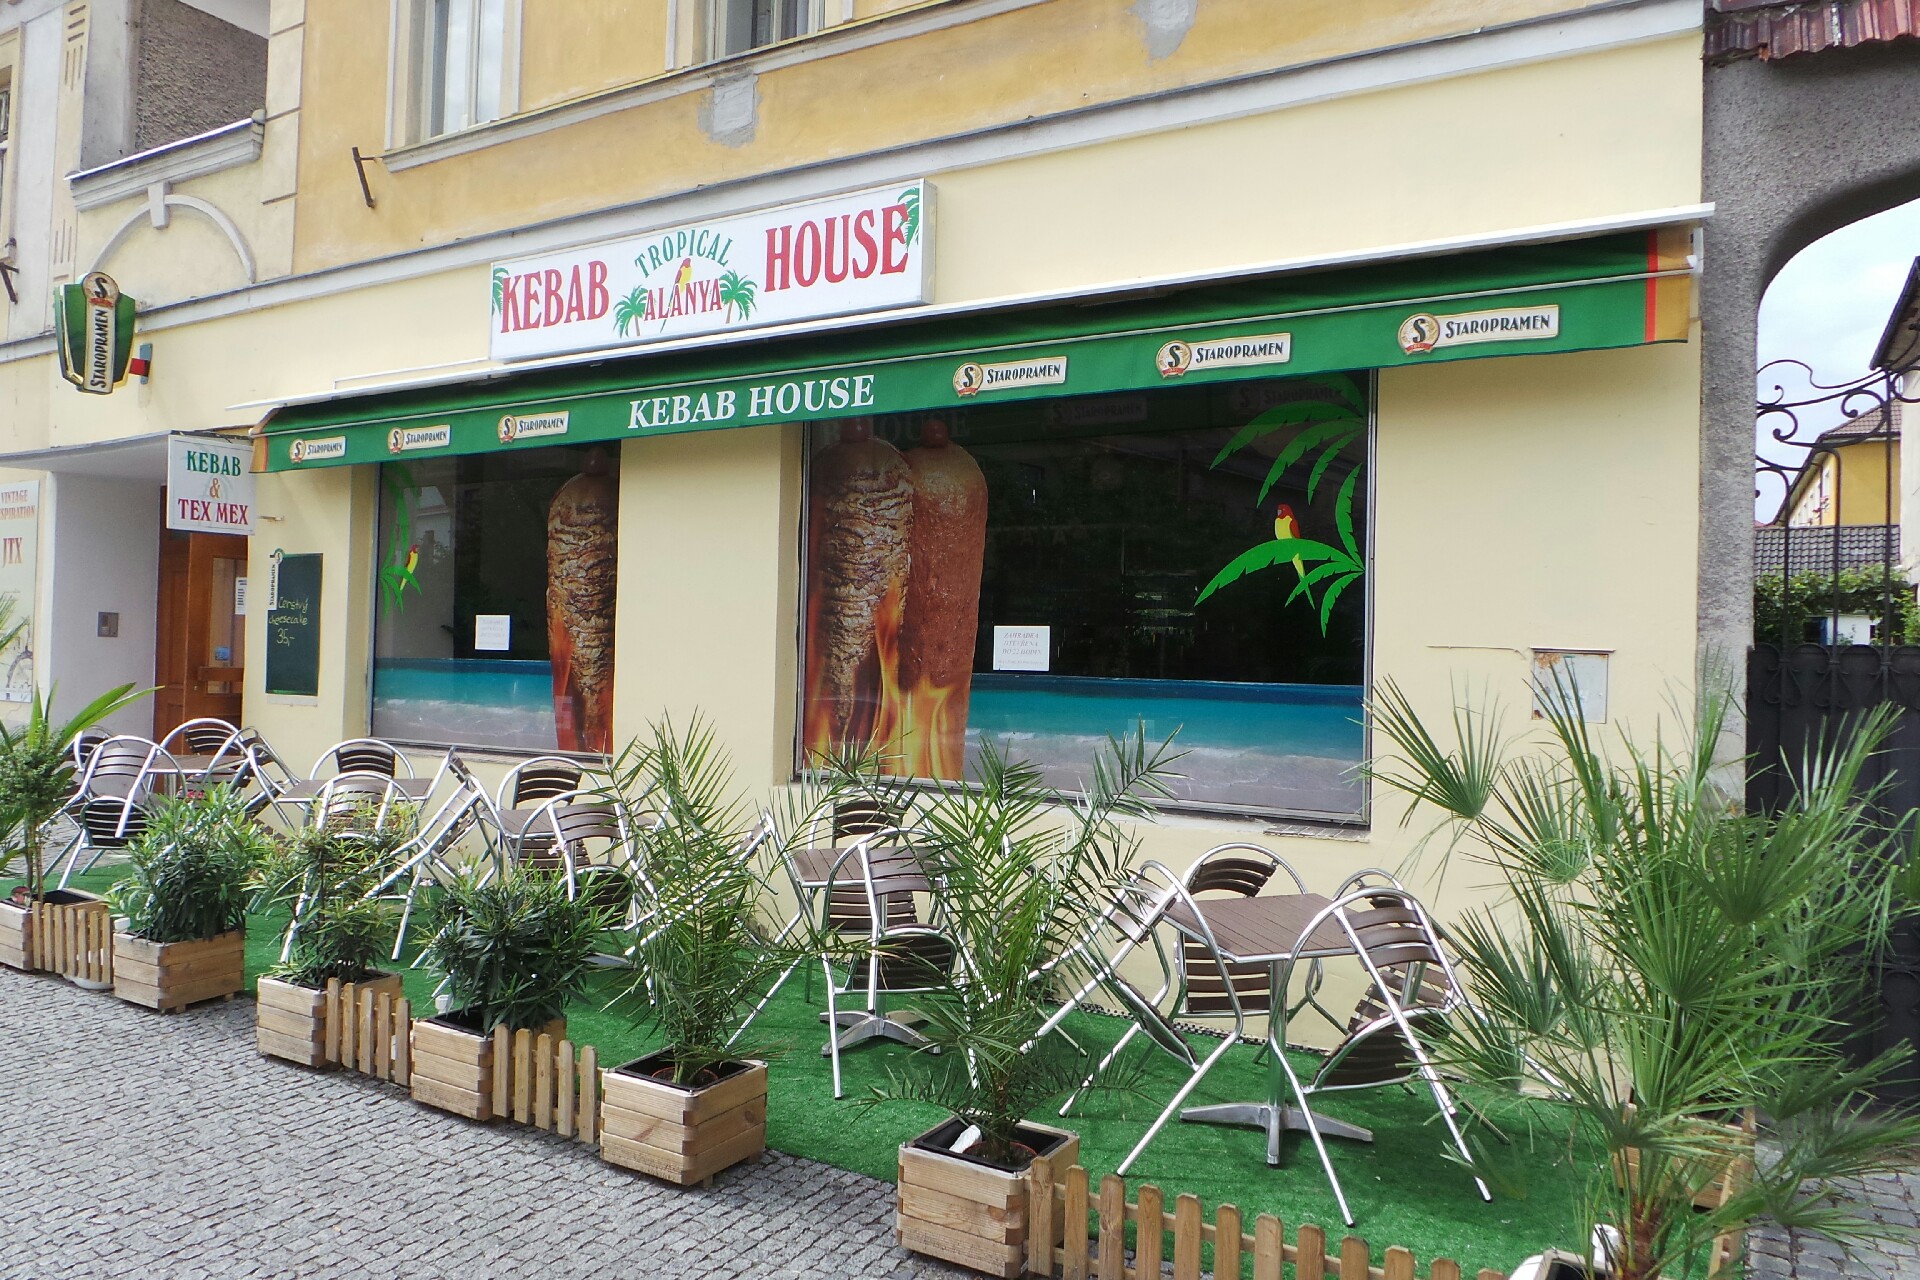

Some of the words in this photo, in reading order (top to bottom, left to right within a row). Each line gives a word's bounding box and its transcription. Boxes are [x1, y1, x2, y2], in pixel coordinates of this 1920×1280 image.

[634, 229, 734, 278] TROPICAL
[500, 260, 610, 334] KEBAB
[764, 202, 909, 294] HOUSE
[643, 278, 723, 322] ALANYA
[1445, 314, 1551, 339] STAROPRAMEN
[90, 309, 109, 389] STAROPRAMEN
[1195, 341, 1284, 363] STAROPRAMEN
[987, 363, 1061, 384] STAROPRAMEN
[627, 390, 737, 430] KEBAB
[748, 374, 875, 418] HOUSE
[518, 416, 565, 433] STAROPRAMEN
[405, 431, 448, 446] STAROPRAMEN
[187, 450, 242, 477] KEBAB
[1, 489, 29, 504] VINTAGE
[209, 478, 220, 499] &
[0, 505, 36, 521] SPIRATION
[178, 498, 212, 522] TEX
[216, 502, 249, 526] MEX
[2, 537, 23, 568] JTX
